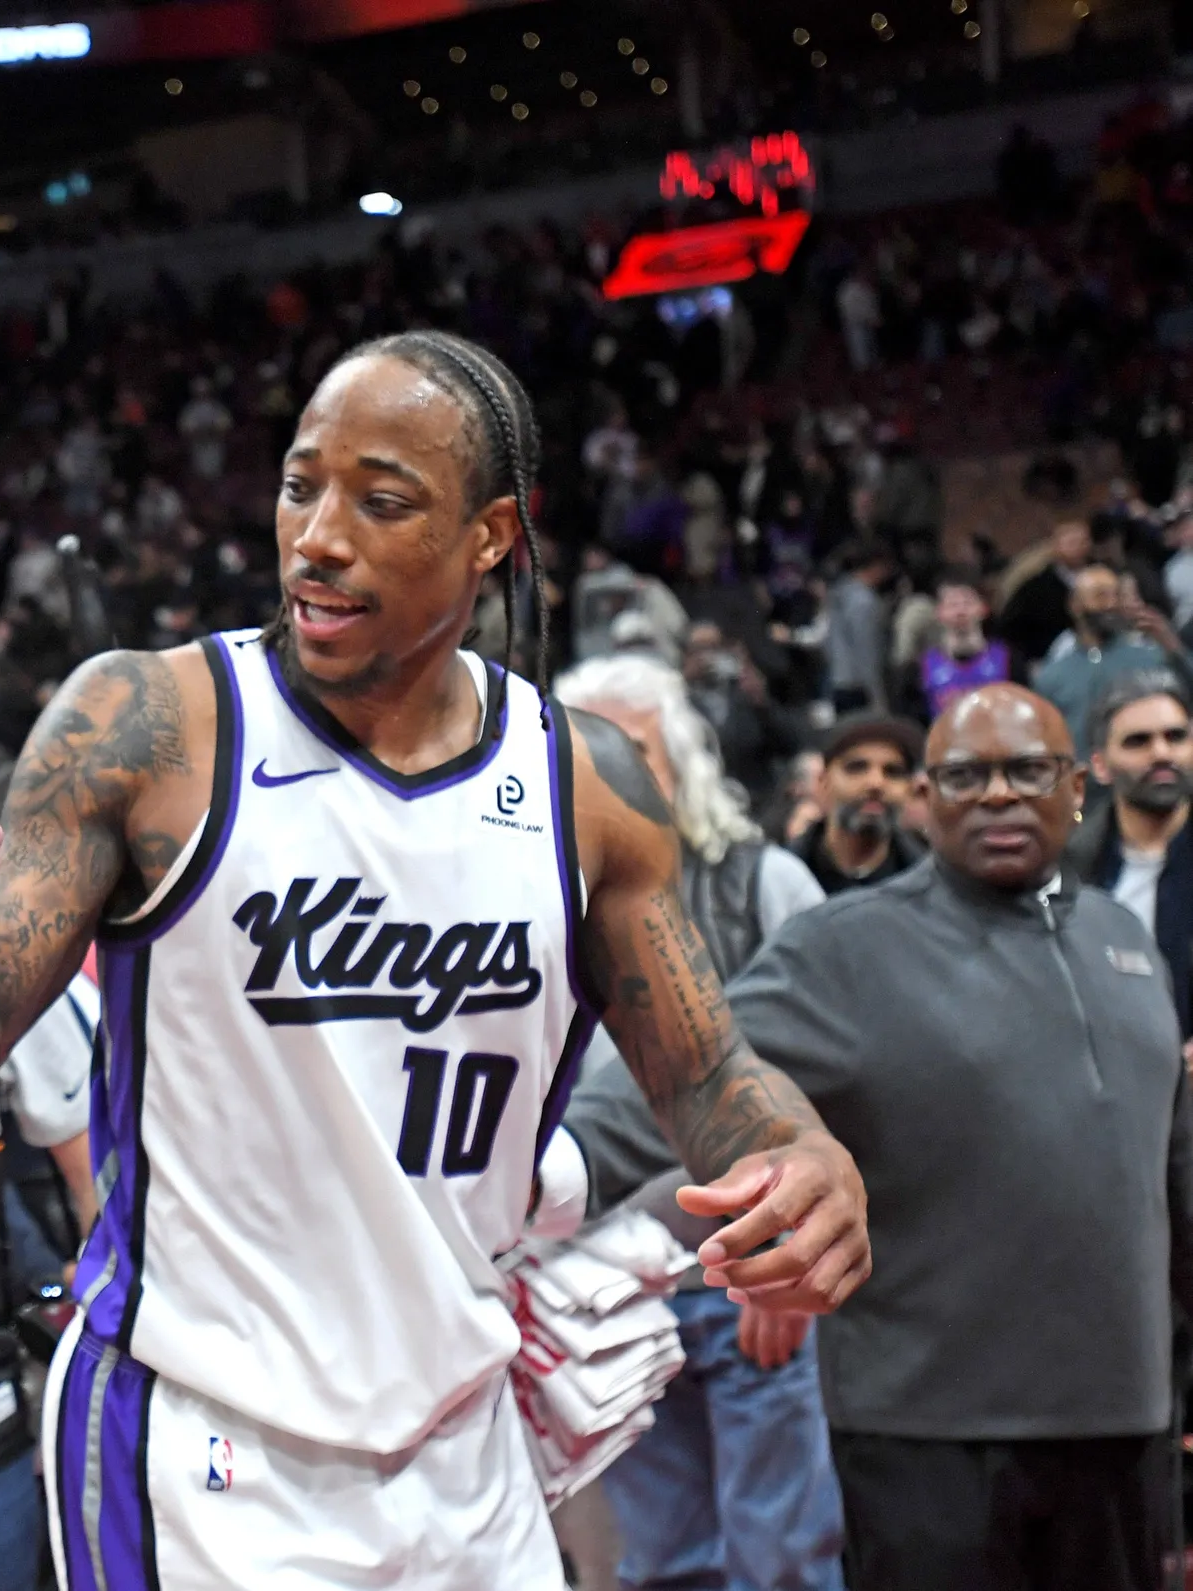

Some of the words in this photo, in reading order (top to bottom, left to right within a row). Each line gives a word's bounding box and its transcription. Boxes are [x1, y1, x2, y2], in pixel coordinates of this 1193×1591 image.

[481, 815, 520, 829] PHOONG
[522, 823, 543, 833] LAW
[232, 877, 542, 1033] Kings
[397, 1046, 520, 1179] 10
